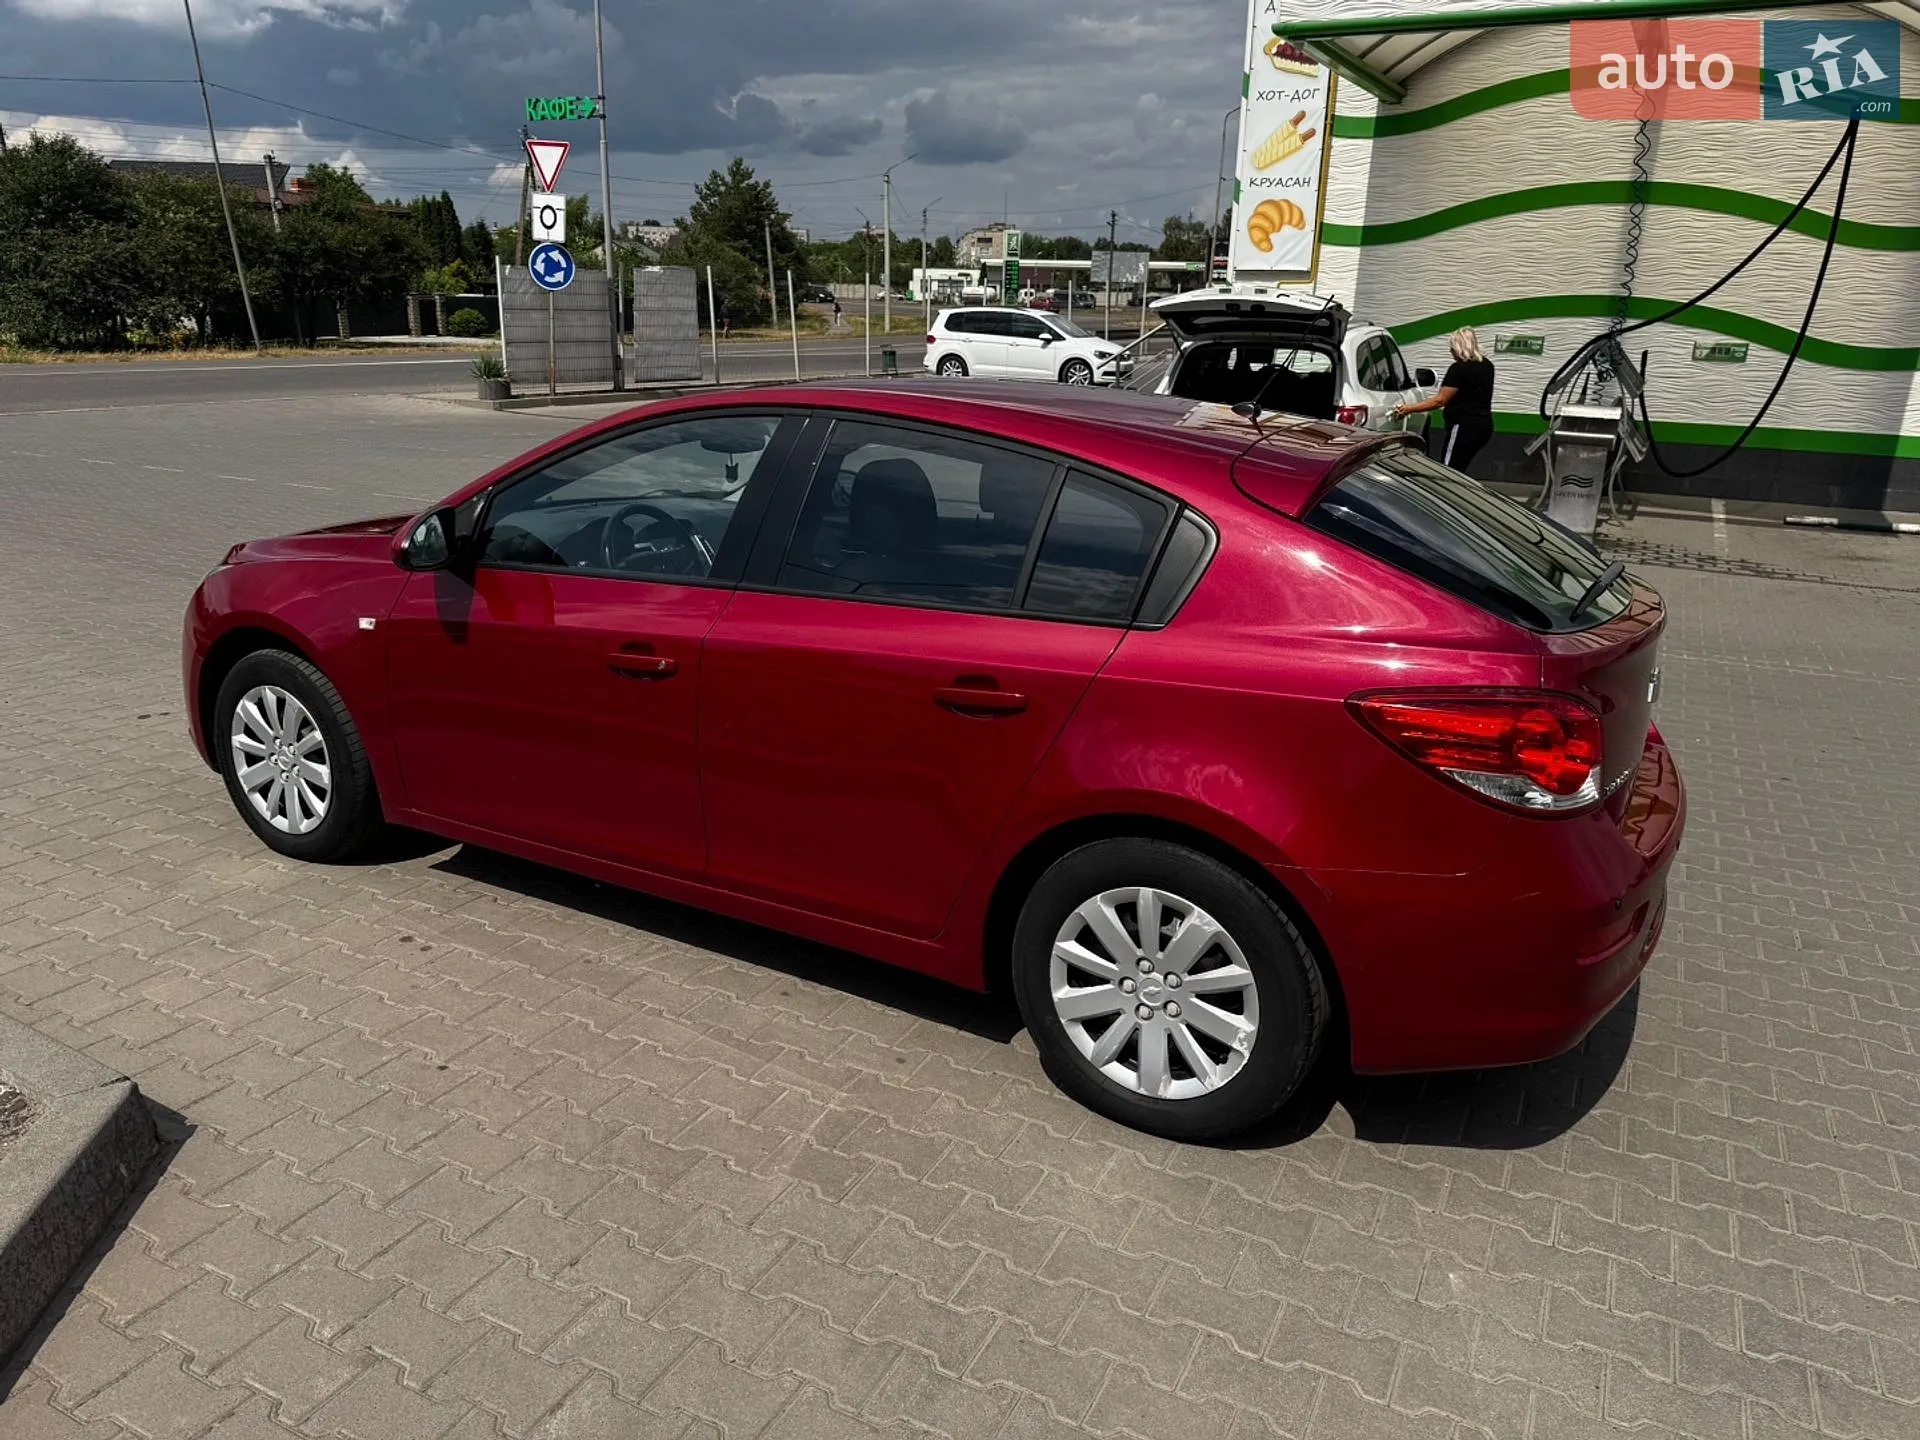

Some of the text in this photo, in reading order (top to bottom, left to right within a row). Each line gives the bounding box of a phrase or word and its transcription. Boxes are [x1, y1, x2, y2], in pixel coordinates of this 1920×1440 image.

[1256, 88, 1321, 103] ХОТ-ДОГ
[525, 97, 578, 121] КАФЕ
[1249, 176, 1312, 188] КРУАСАН
